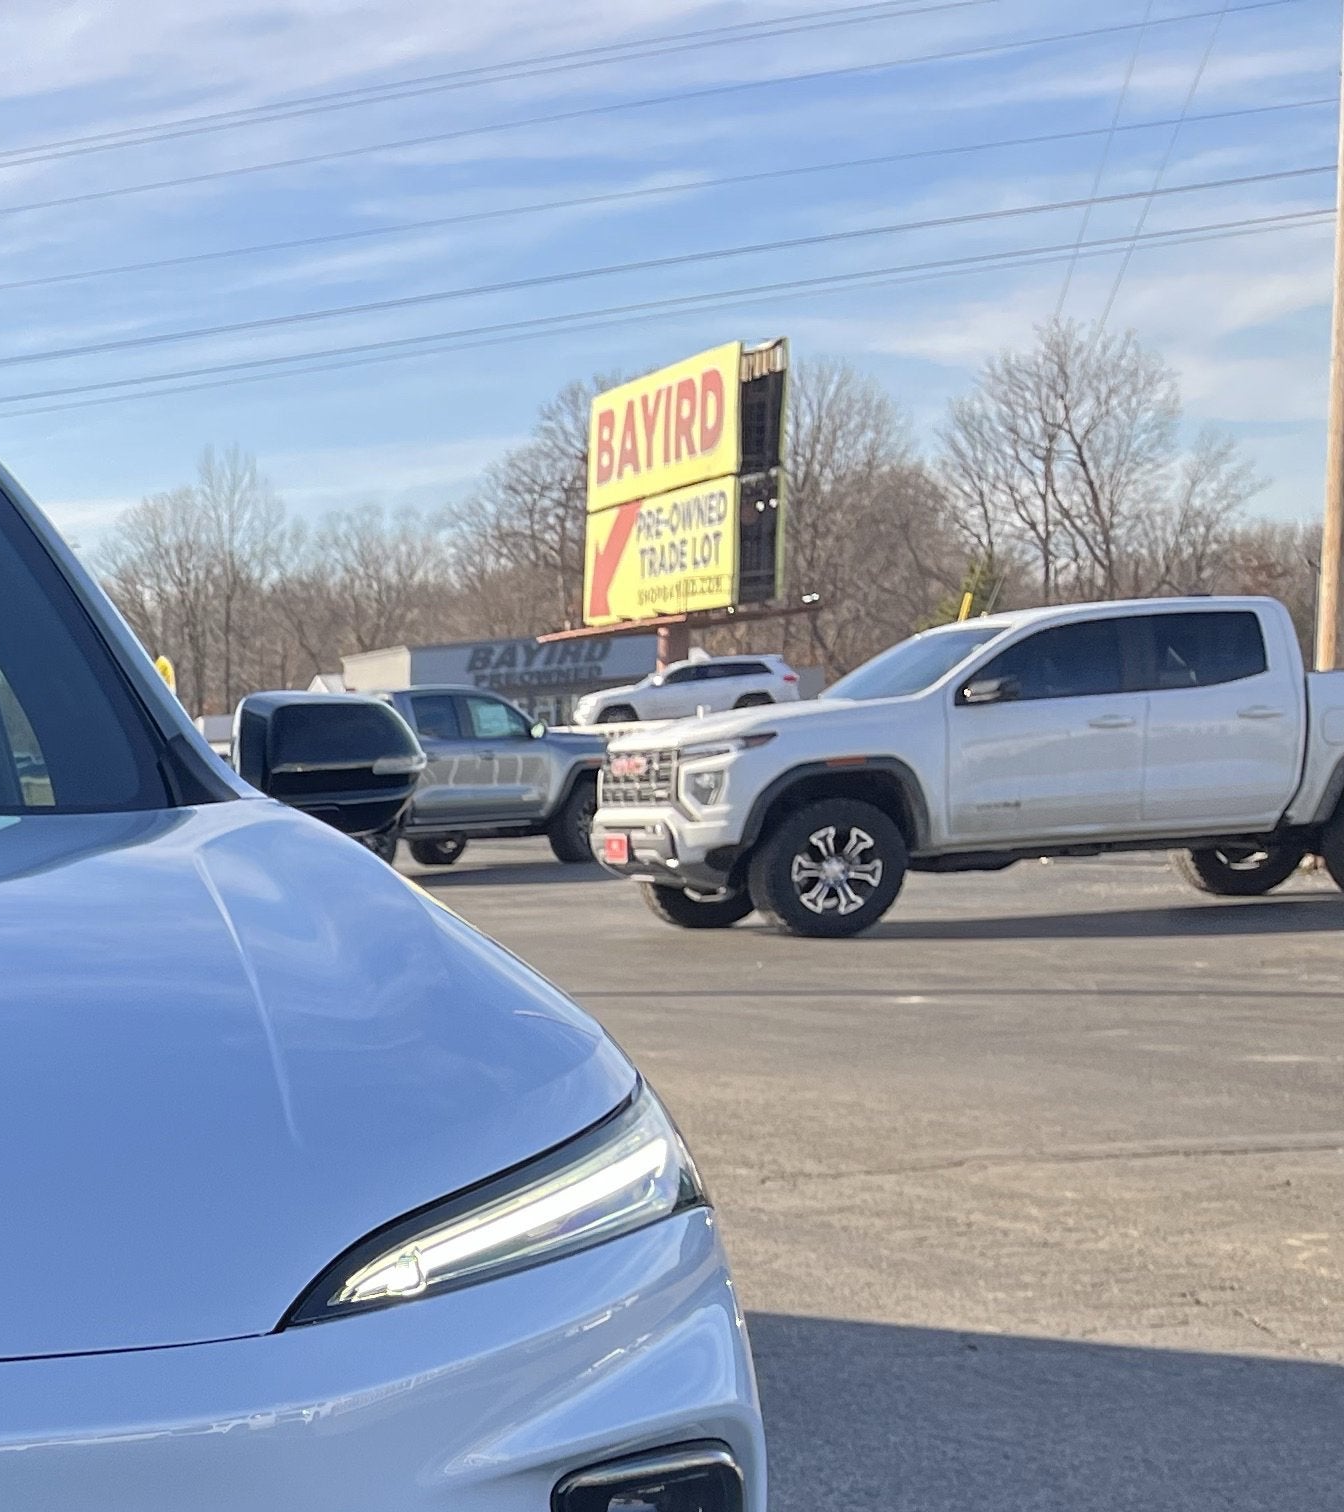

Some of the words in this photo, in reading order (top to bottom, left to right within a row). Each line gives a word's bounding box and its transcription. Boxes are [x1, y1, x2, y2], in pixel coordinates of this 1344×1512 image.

[596, 368, 725, 487] BAYIRD
[636, 490, 728, 542] PRE-OWNED
[639, 537, 688, 579] TRADE
[691, 530, 722, 569] LOT
[467, 636, 612, 673] BAYIRD
